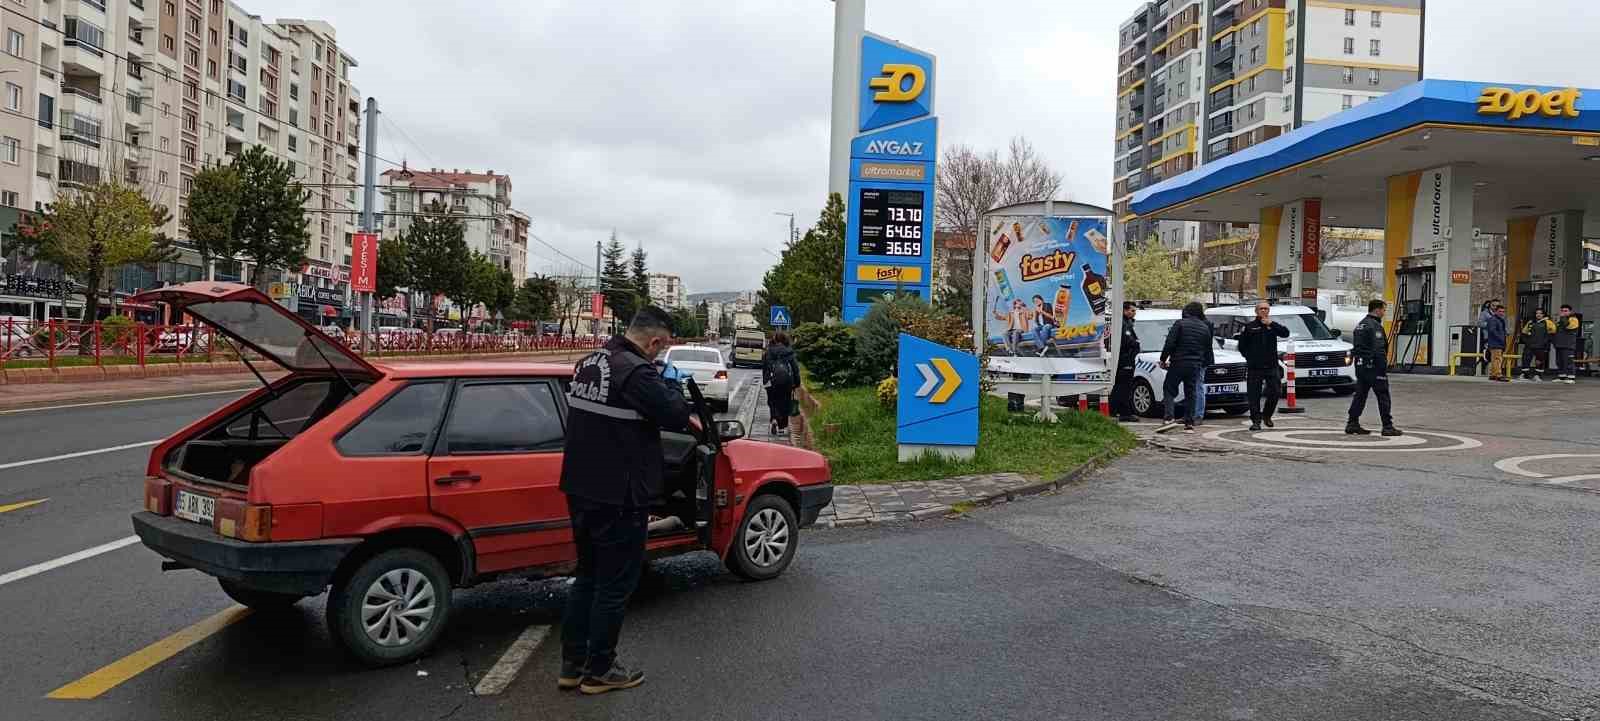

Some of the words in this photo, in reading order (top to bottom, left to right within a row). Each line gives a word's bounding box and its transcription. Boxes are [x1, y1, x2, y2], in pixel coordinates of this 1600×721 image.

[863, 140, 924, 155] AYGAZ
[864, 166, 922, 177] ultramarket
[1431, 173, 1442, 235] ultraforce
[887, 207, 922, 221] 73.70
[885, 241, 921, 256] 36.69
[1021, 249, 1075, 278] fasty
[876, 267, 904, 280] fasty
